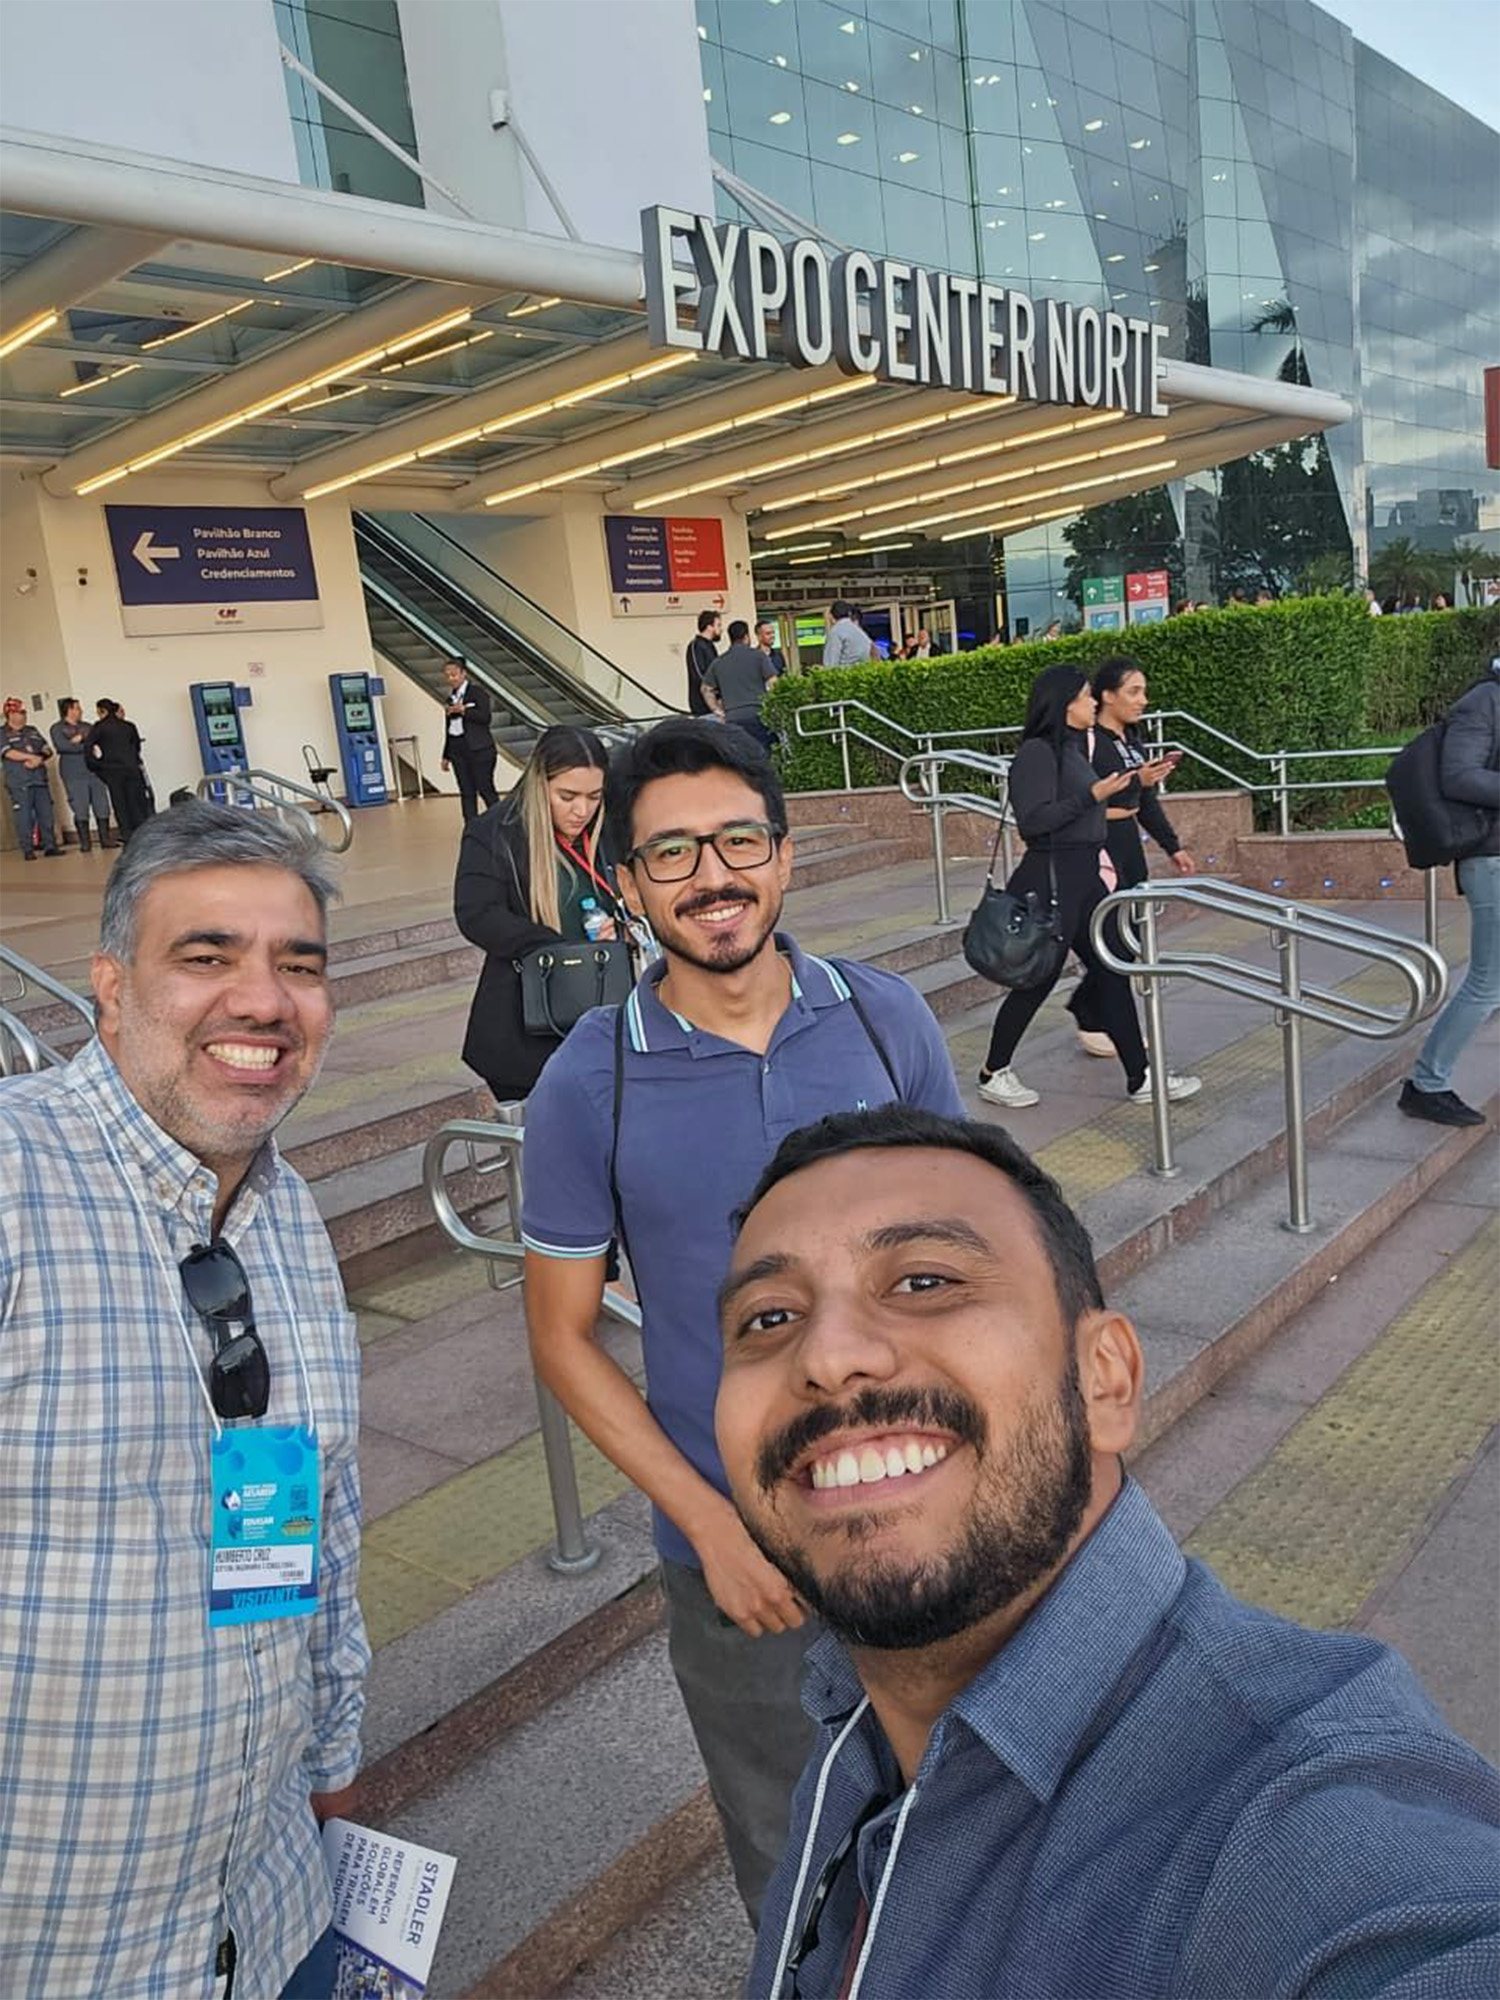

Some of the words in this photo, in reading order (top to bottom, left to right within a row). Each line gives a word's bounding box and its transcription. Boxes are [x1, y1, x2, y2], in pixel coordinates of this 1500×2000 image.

[645, 205, 832, 368] EXPO
[838, 251, 1036, 399] CENTER
[1046, 299, 1170, 417] NORTE
[193, 527, 241, 539] Pavilhão
[243, 528, 281, 538] Branco
[197, 547, 244, 559] Pavilhão
[246, 548, 270, 558] Azul
[201, 566, 296, 579] Credenciamentos
[232, 1586, 300, 1608] VISITANTE
[343, 1832, 356, 1849] DE
[351, 1836, 368, 1869] PARA
[356, 1841, 380, 1906] SOLUÇÕES
[373, 1846, 392, 1893] GLOBAL
[337, 1873, 359, 1926] TRIAGEM
[378, 1850, 405, 1925] REFERÊNCIA
[405, 1861, 439, 1945] STADLER
[367, 1897, 380, 1915] EM
